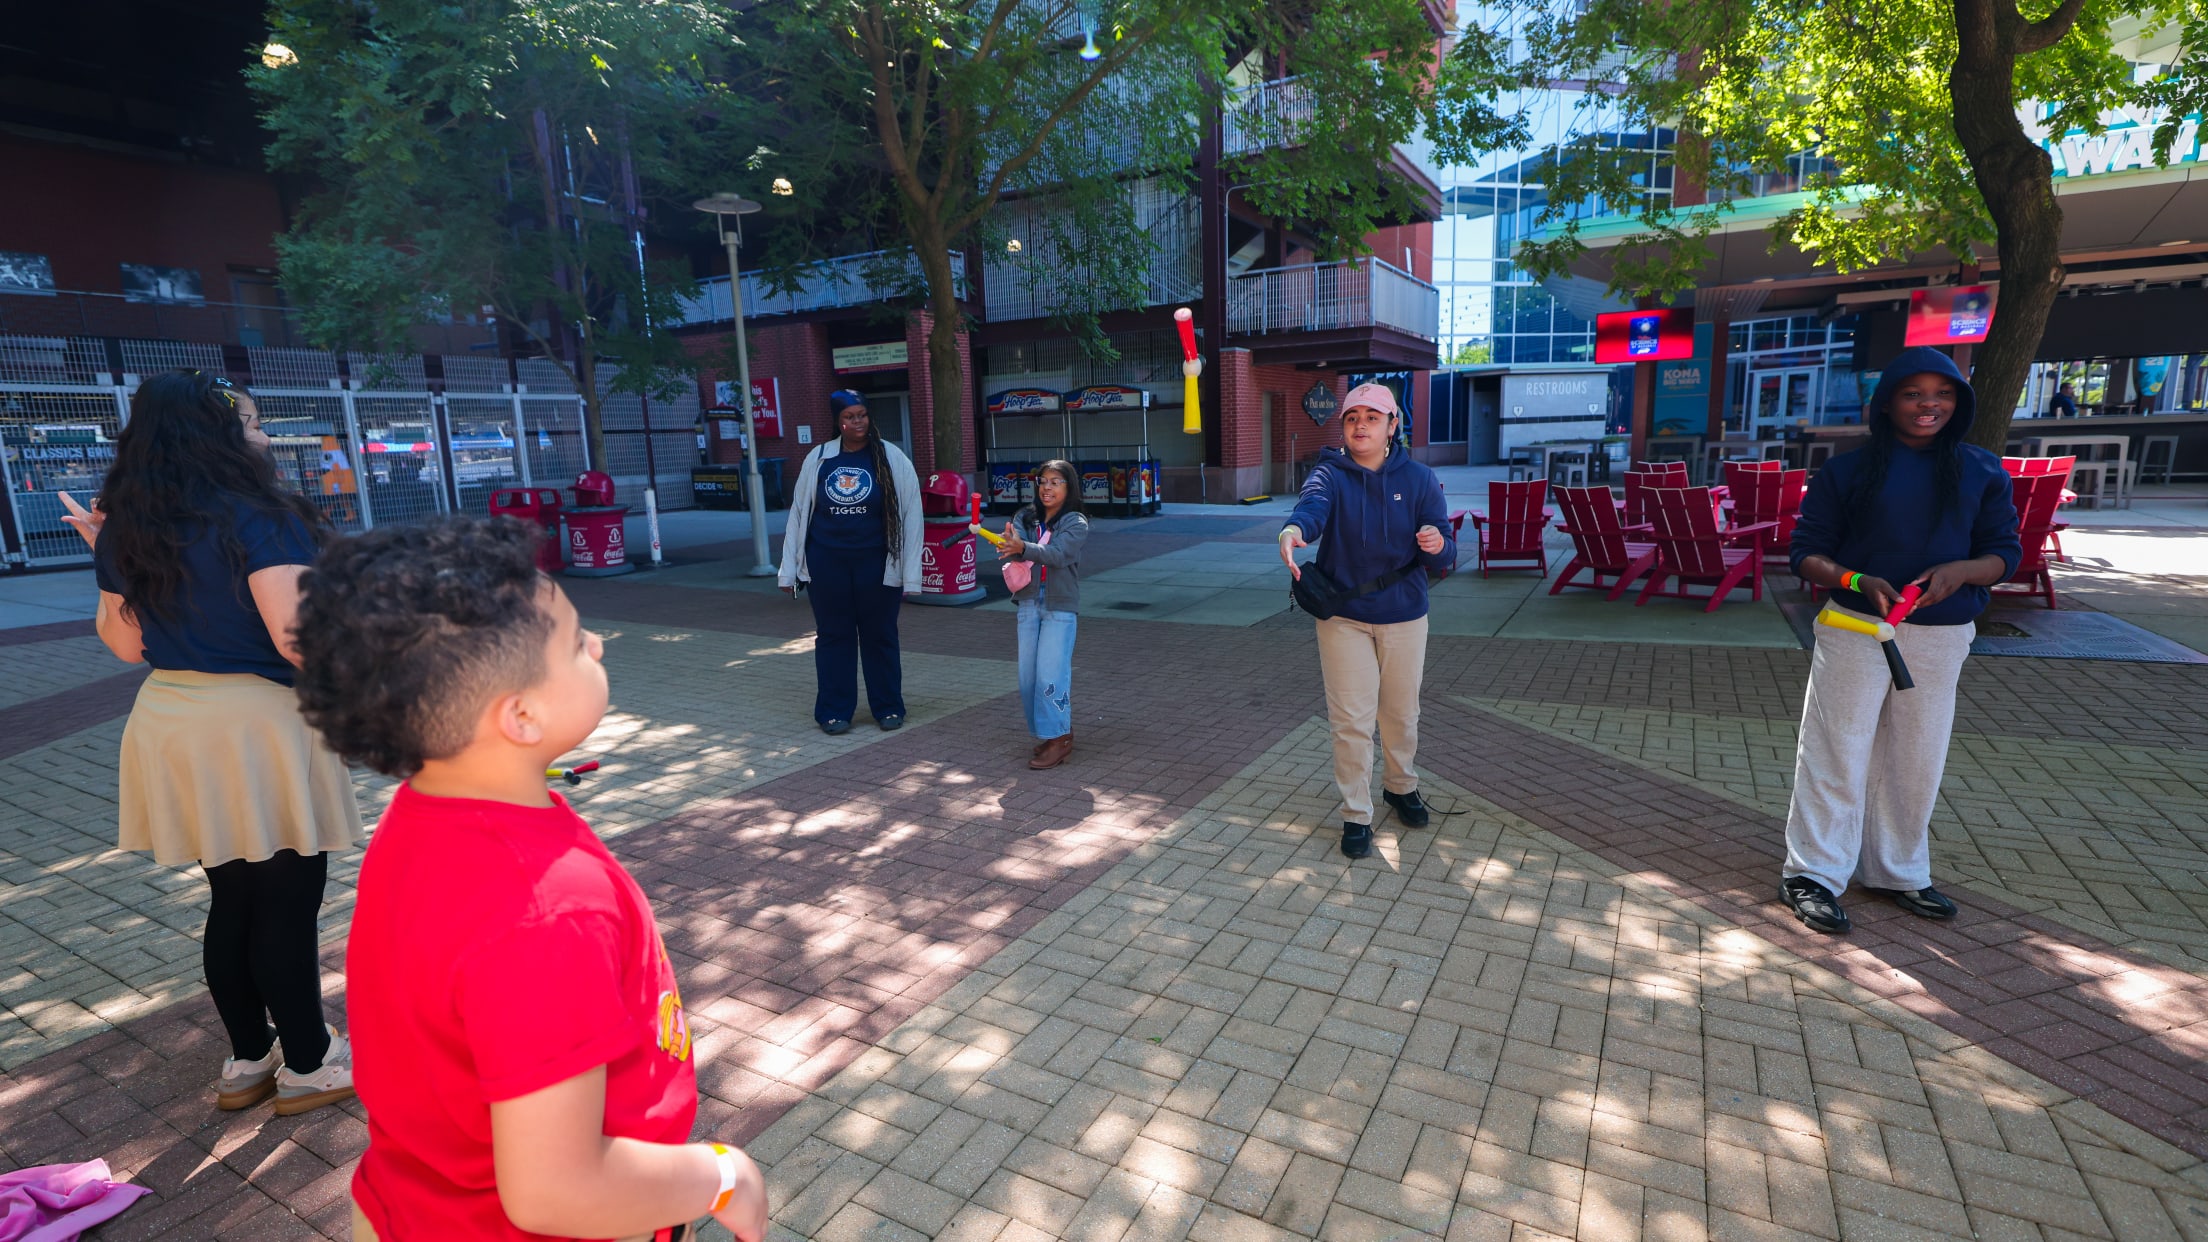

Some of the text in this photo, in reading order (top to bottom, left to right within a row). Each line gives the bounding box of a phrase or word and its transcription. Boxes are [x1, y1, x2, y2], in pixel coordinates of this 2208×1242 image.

[2060, 123, 2208, 178] WAV
[1663, 367, 1701, 379] KONA
[1526, 380, 1588, 396] RESTROOMS
[1004, 394, 1043, 409] Hoop Tea
[1082, 391, 1124, 408] Hoop Tea
[23, 446, 83, 459] CLASSICS
[694, 482, 716, 490] DECIDE
[929, 474, 939, 488] P
[829, 505, 867, 515] TIGERS
